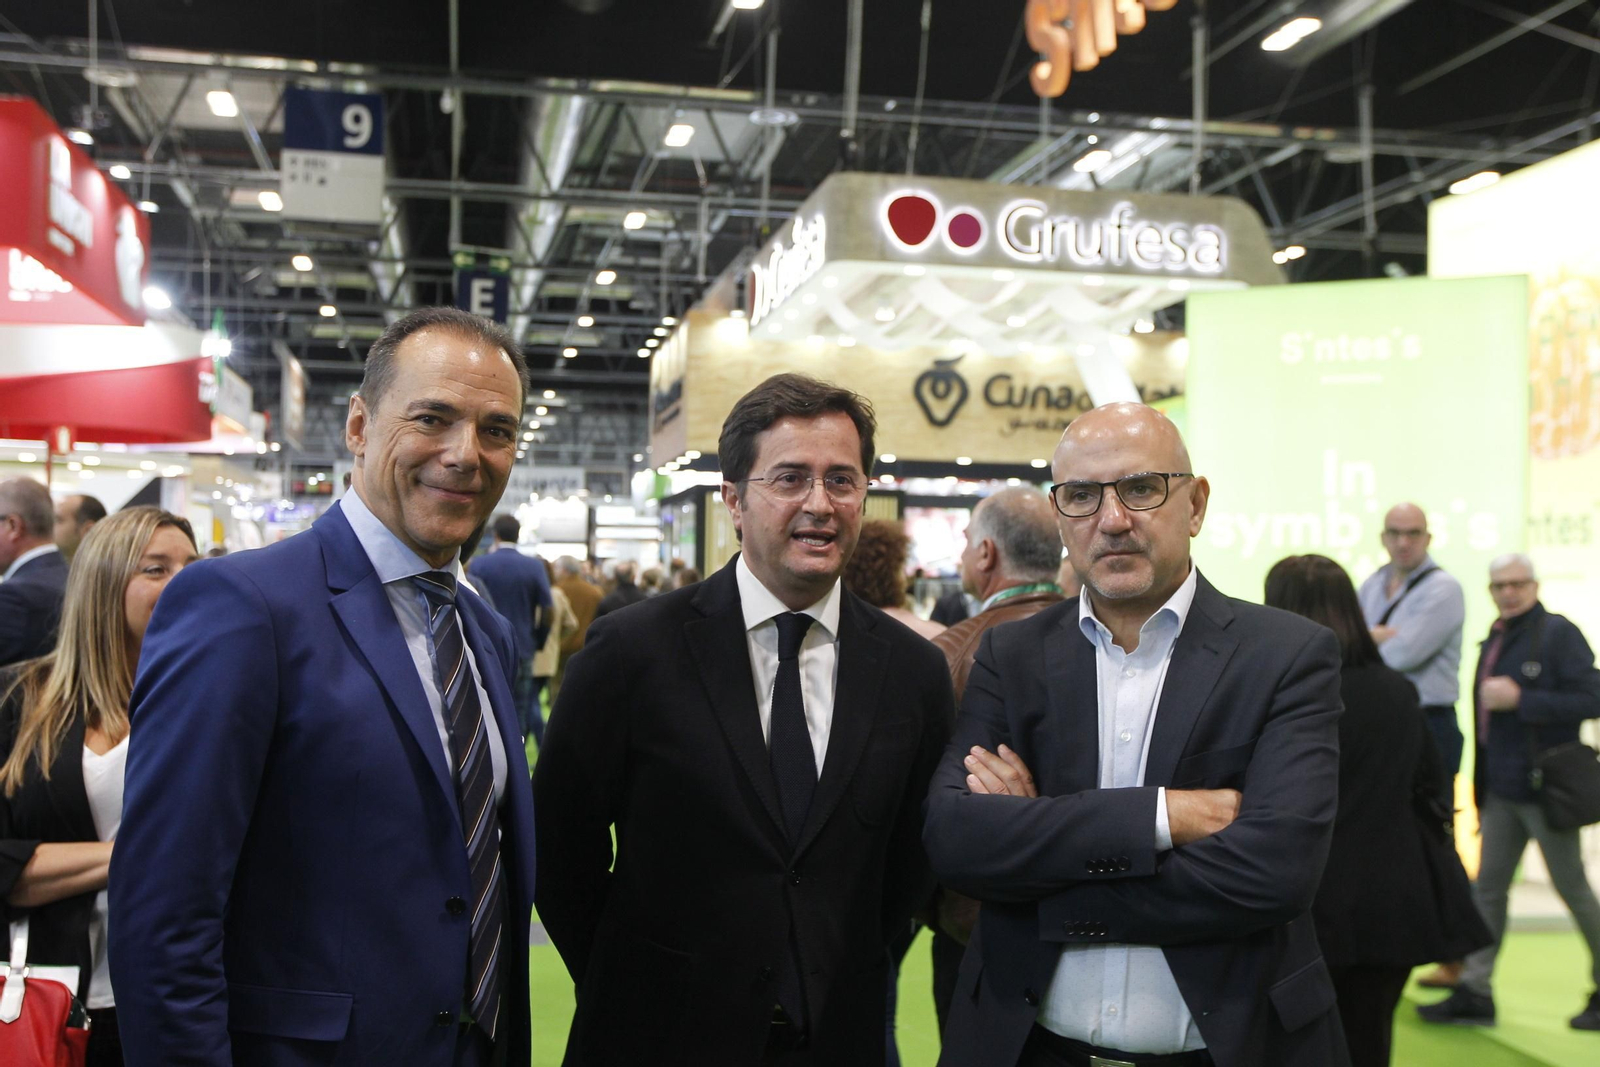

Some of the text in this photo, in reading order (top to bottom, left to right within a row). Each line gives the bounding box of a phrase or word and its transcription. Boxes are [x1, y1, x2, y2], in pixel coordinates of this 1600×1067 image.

[341, 103, 374, 149] 9
[998, 199, 1226, 272] Grufesa
[470, 278, 496, 317] E
[1323, 449, 1377, 497] In
